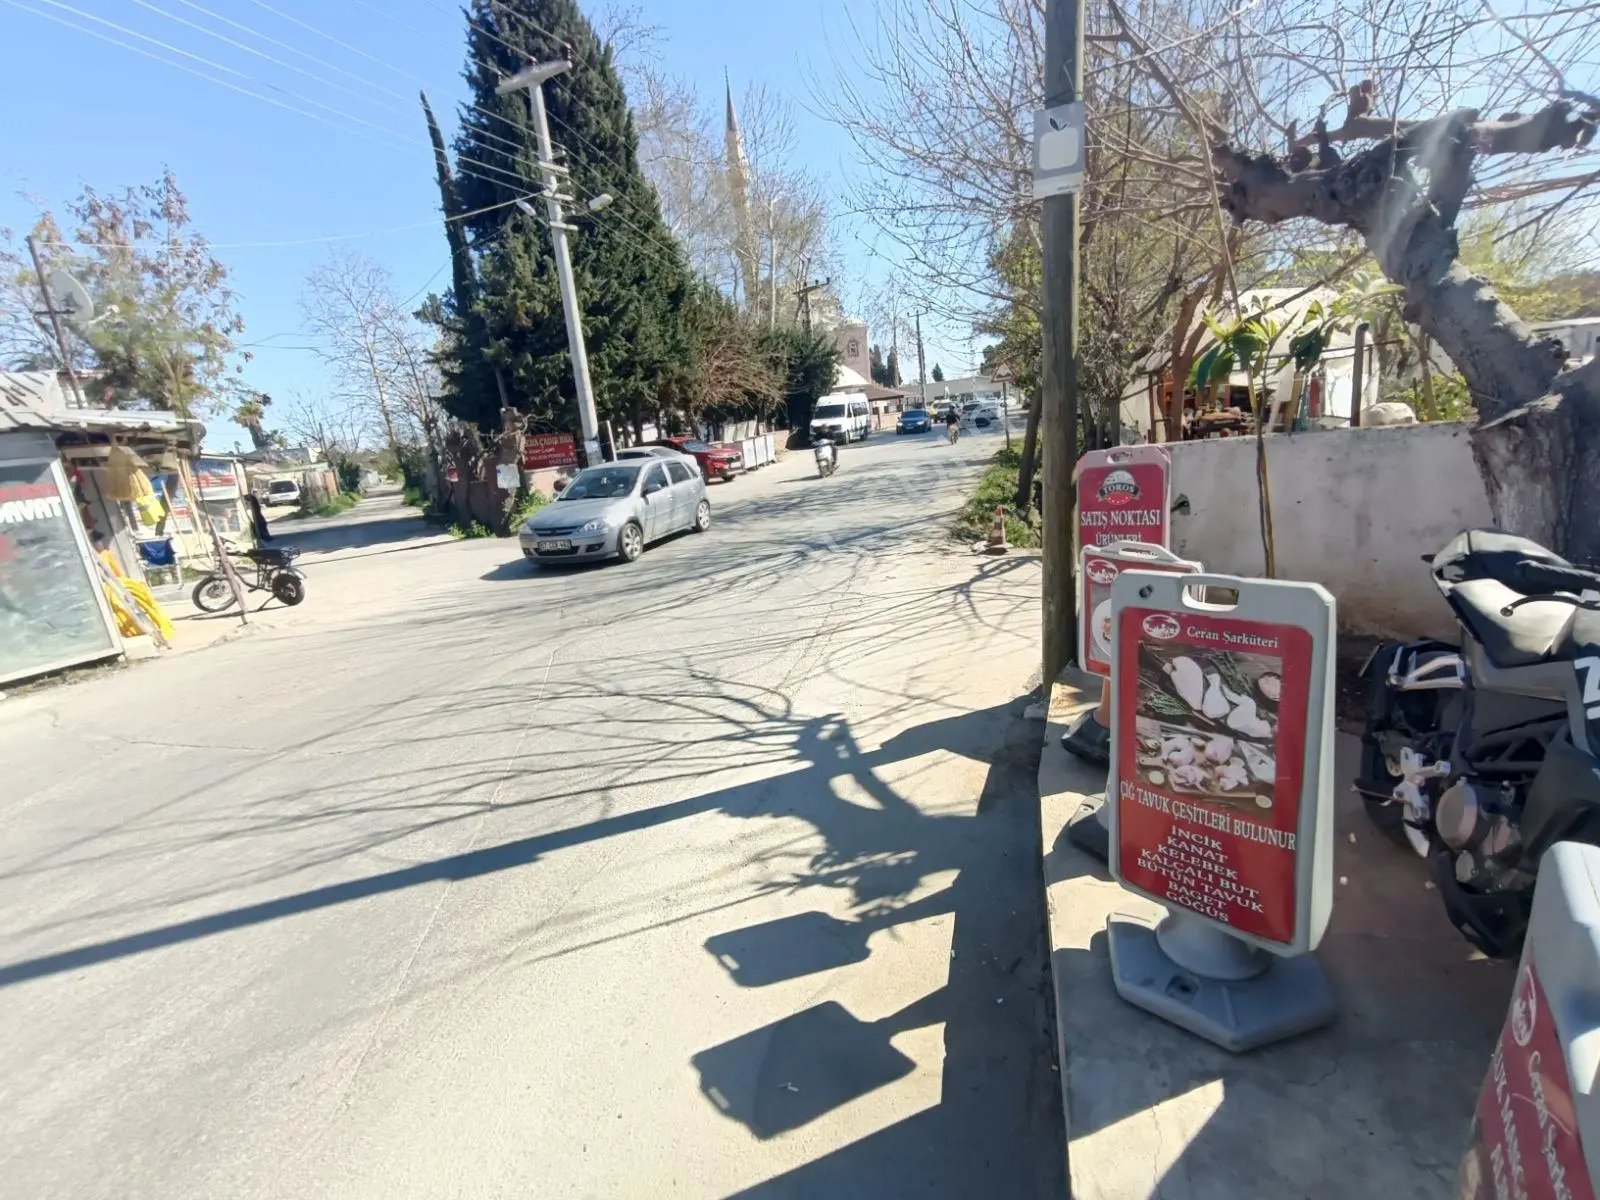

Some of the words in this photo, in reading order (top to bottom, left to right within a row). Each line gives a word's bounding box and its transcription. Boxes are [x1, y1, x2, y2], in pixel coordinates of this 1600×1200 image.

[1103, 483, 1135, 494] TOROS
[1080, 511, 1108, 529] SATIŞ
[1110, 509, 1161, 526] NOKTASI
[1186, 626, 1219, 641] Ceran
[1222, 631, 1279, 649] Şarküteri
[1120, 780, 1136, 801] ÇİĞ
[1136, 788, 1170, 814] TAVUK
[1171, 800, 1231, 833] ÇEŞİTLERİ
[1233, 819, 1297, 850] BULUNUR
[1167, 836, 1229, 863] KANAT
[1171, 825, 1222, 850] İNCİK
[1158, 844, 1239, 880] KELEBEK
[1168, 881, 1228, 909] BAGET
[1201, 883, 1265, 913] TAVUK
[1219, 878, 1260, 899] BUT
